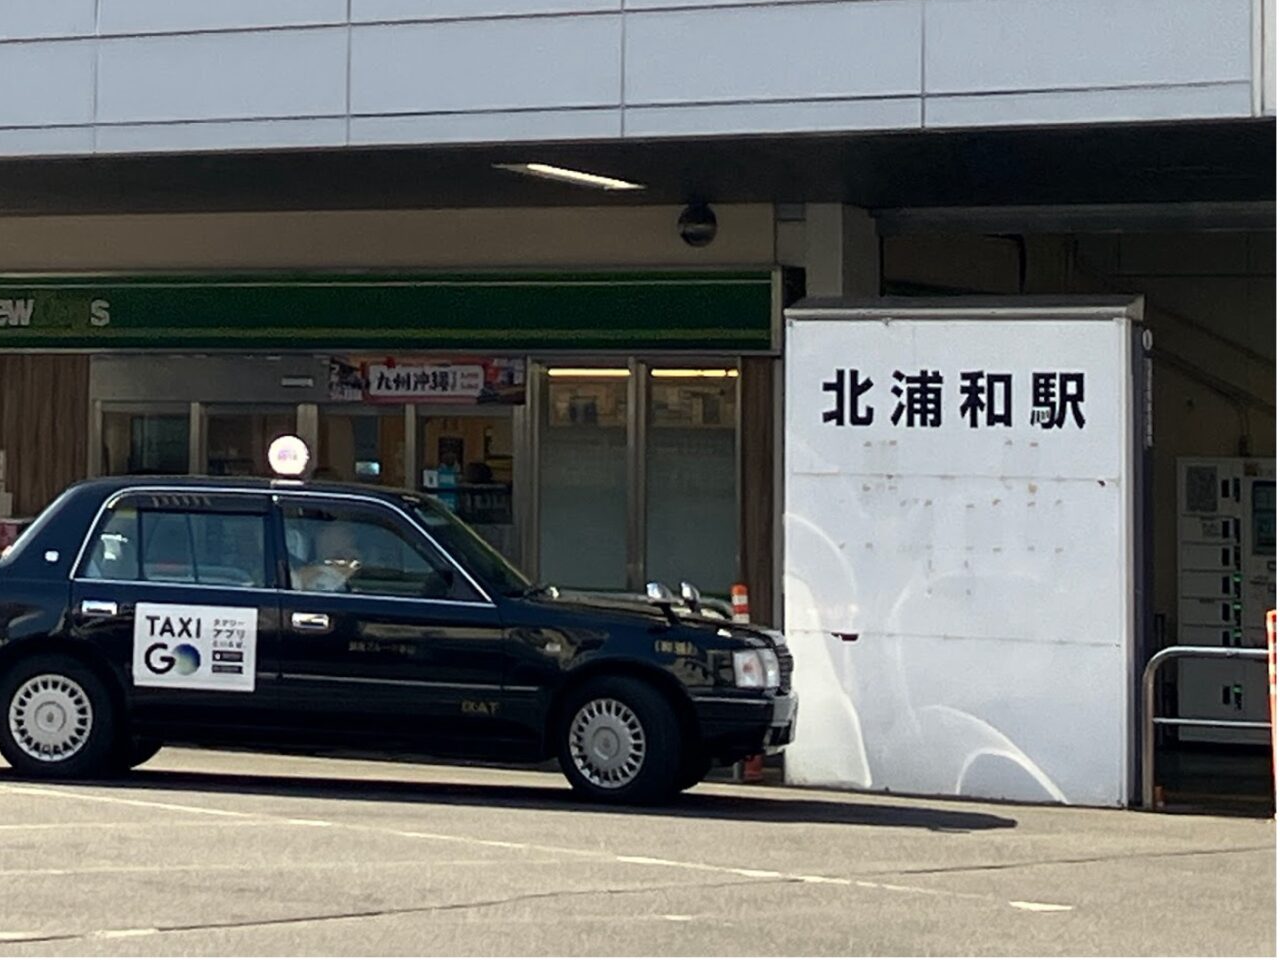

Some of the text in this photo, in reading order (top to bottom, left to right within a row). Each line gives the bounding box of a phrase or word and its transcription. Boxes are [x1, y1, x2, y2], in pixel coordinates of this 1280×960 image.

[822, 368, 1086, 429] 北浦和駅
[146, 615, 201, 638] TAXI
[213, 629, 246, 640] アプリ
[145, 642, 201, 676] GO
